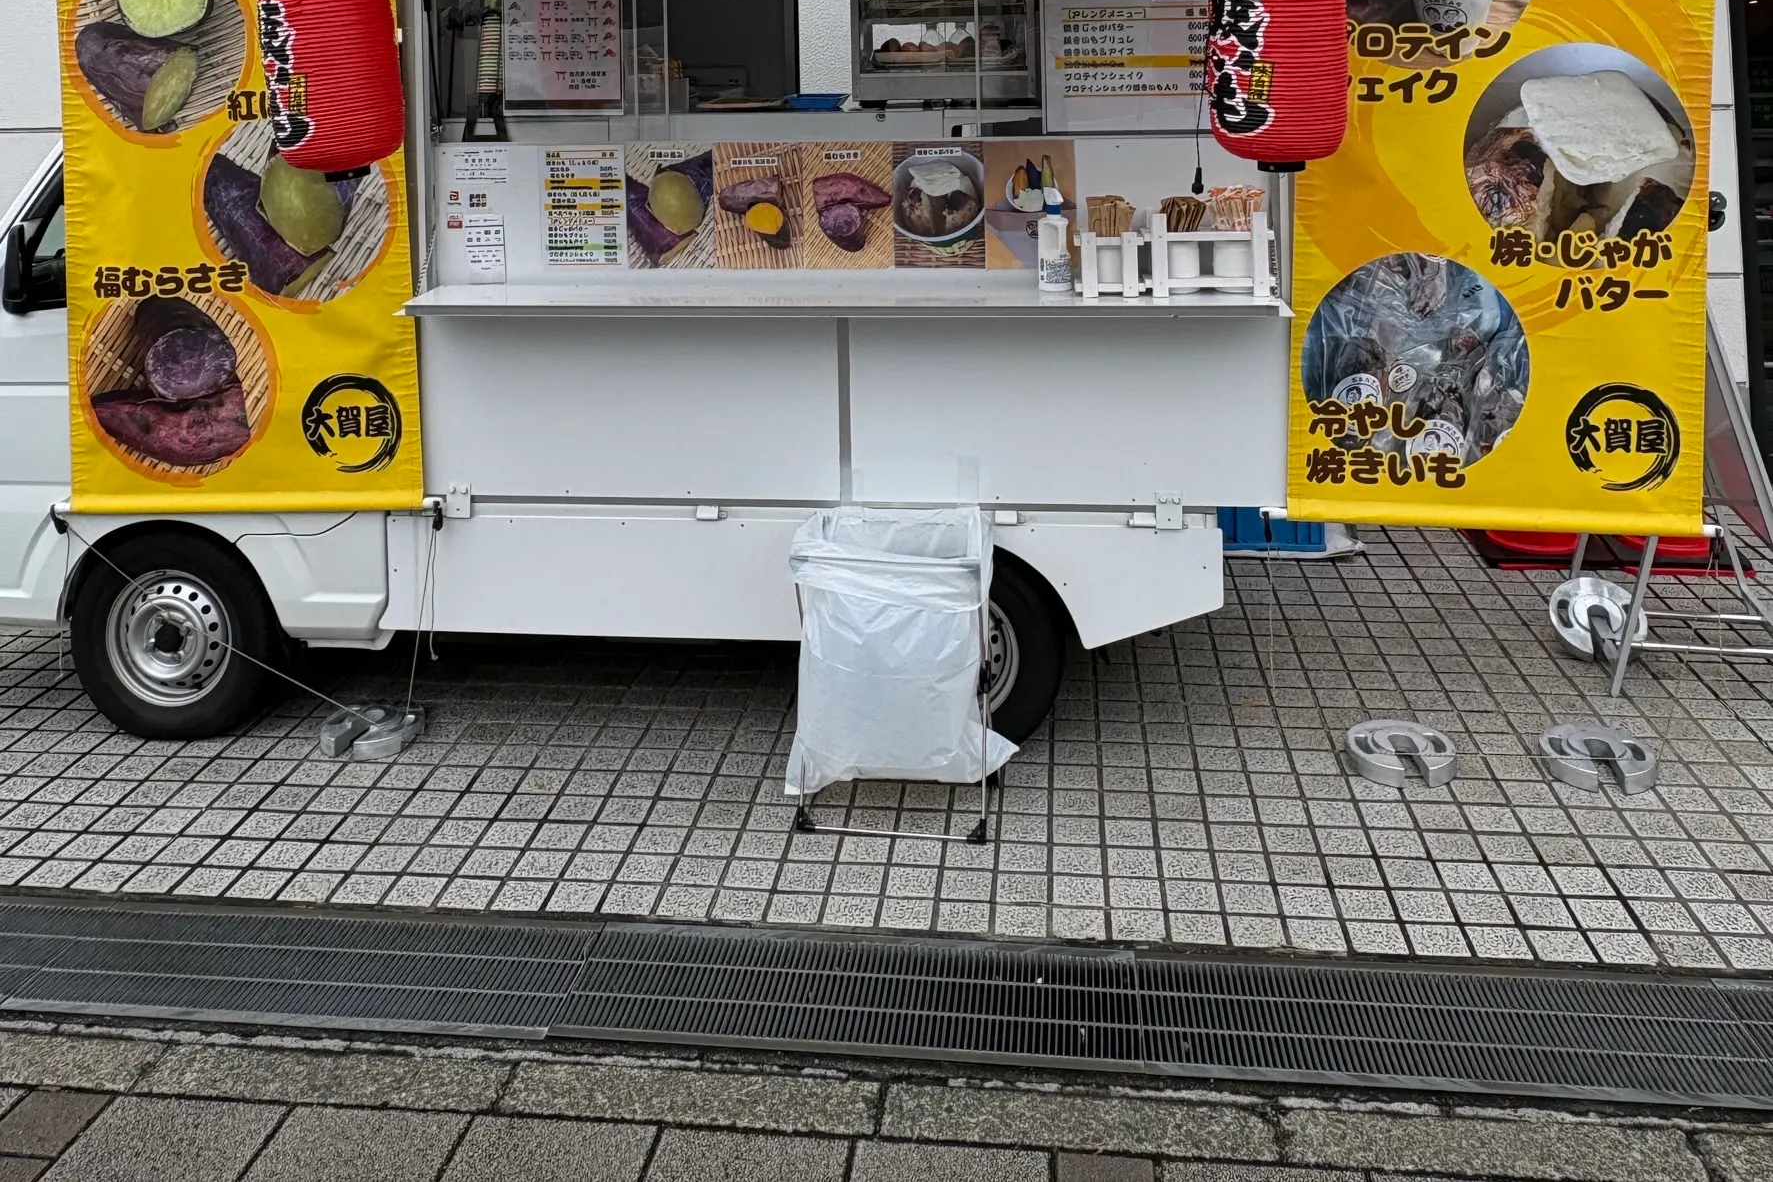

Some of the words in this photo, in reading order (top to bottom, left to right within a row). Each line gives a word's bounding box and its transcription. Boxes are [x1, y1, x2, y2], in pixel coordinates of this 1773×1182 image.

[1347, 70, 1458, 104] ェイク
[93, 261, 249, 299] 福むらさき
[1555, 276, 1670, 312] バター
[305, 404, 393, 440] 大賀屋
[1309, 400, 1425, 439] 冷やし
[1570, 416, 1668, 456] 大賀屋
[1306, 447, 1467, 490] 焼きいも
